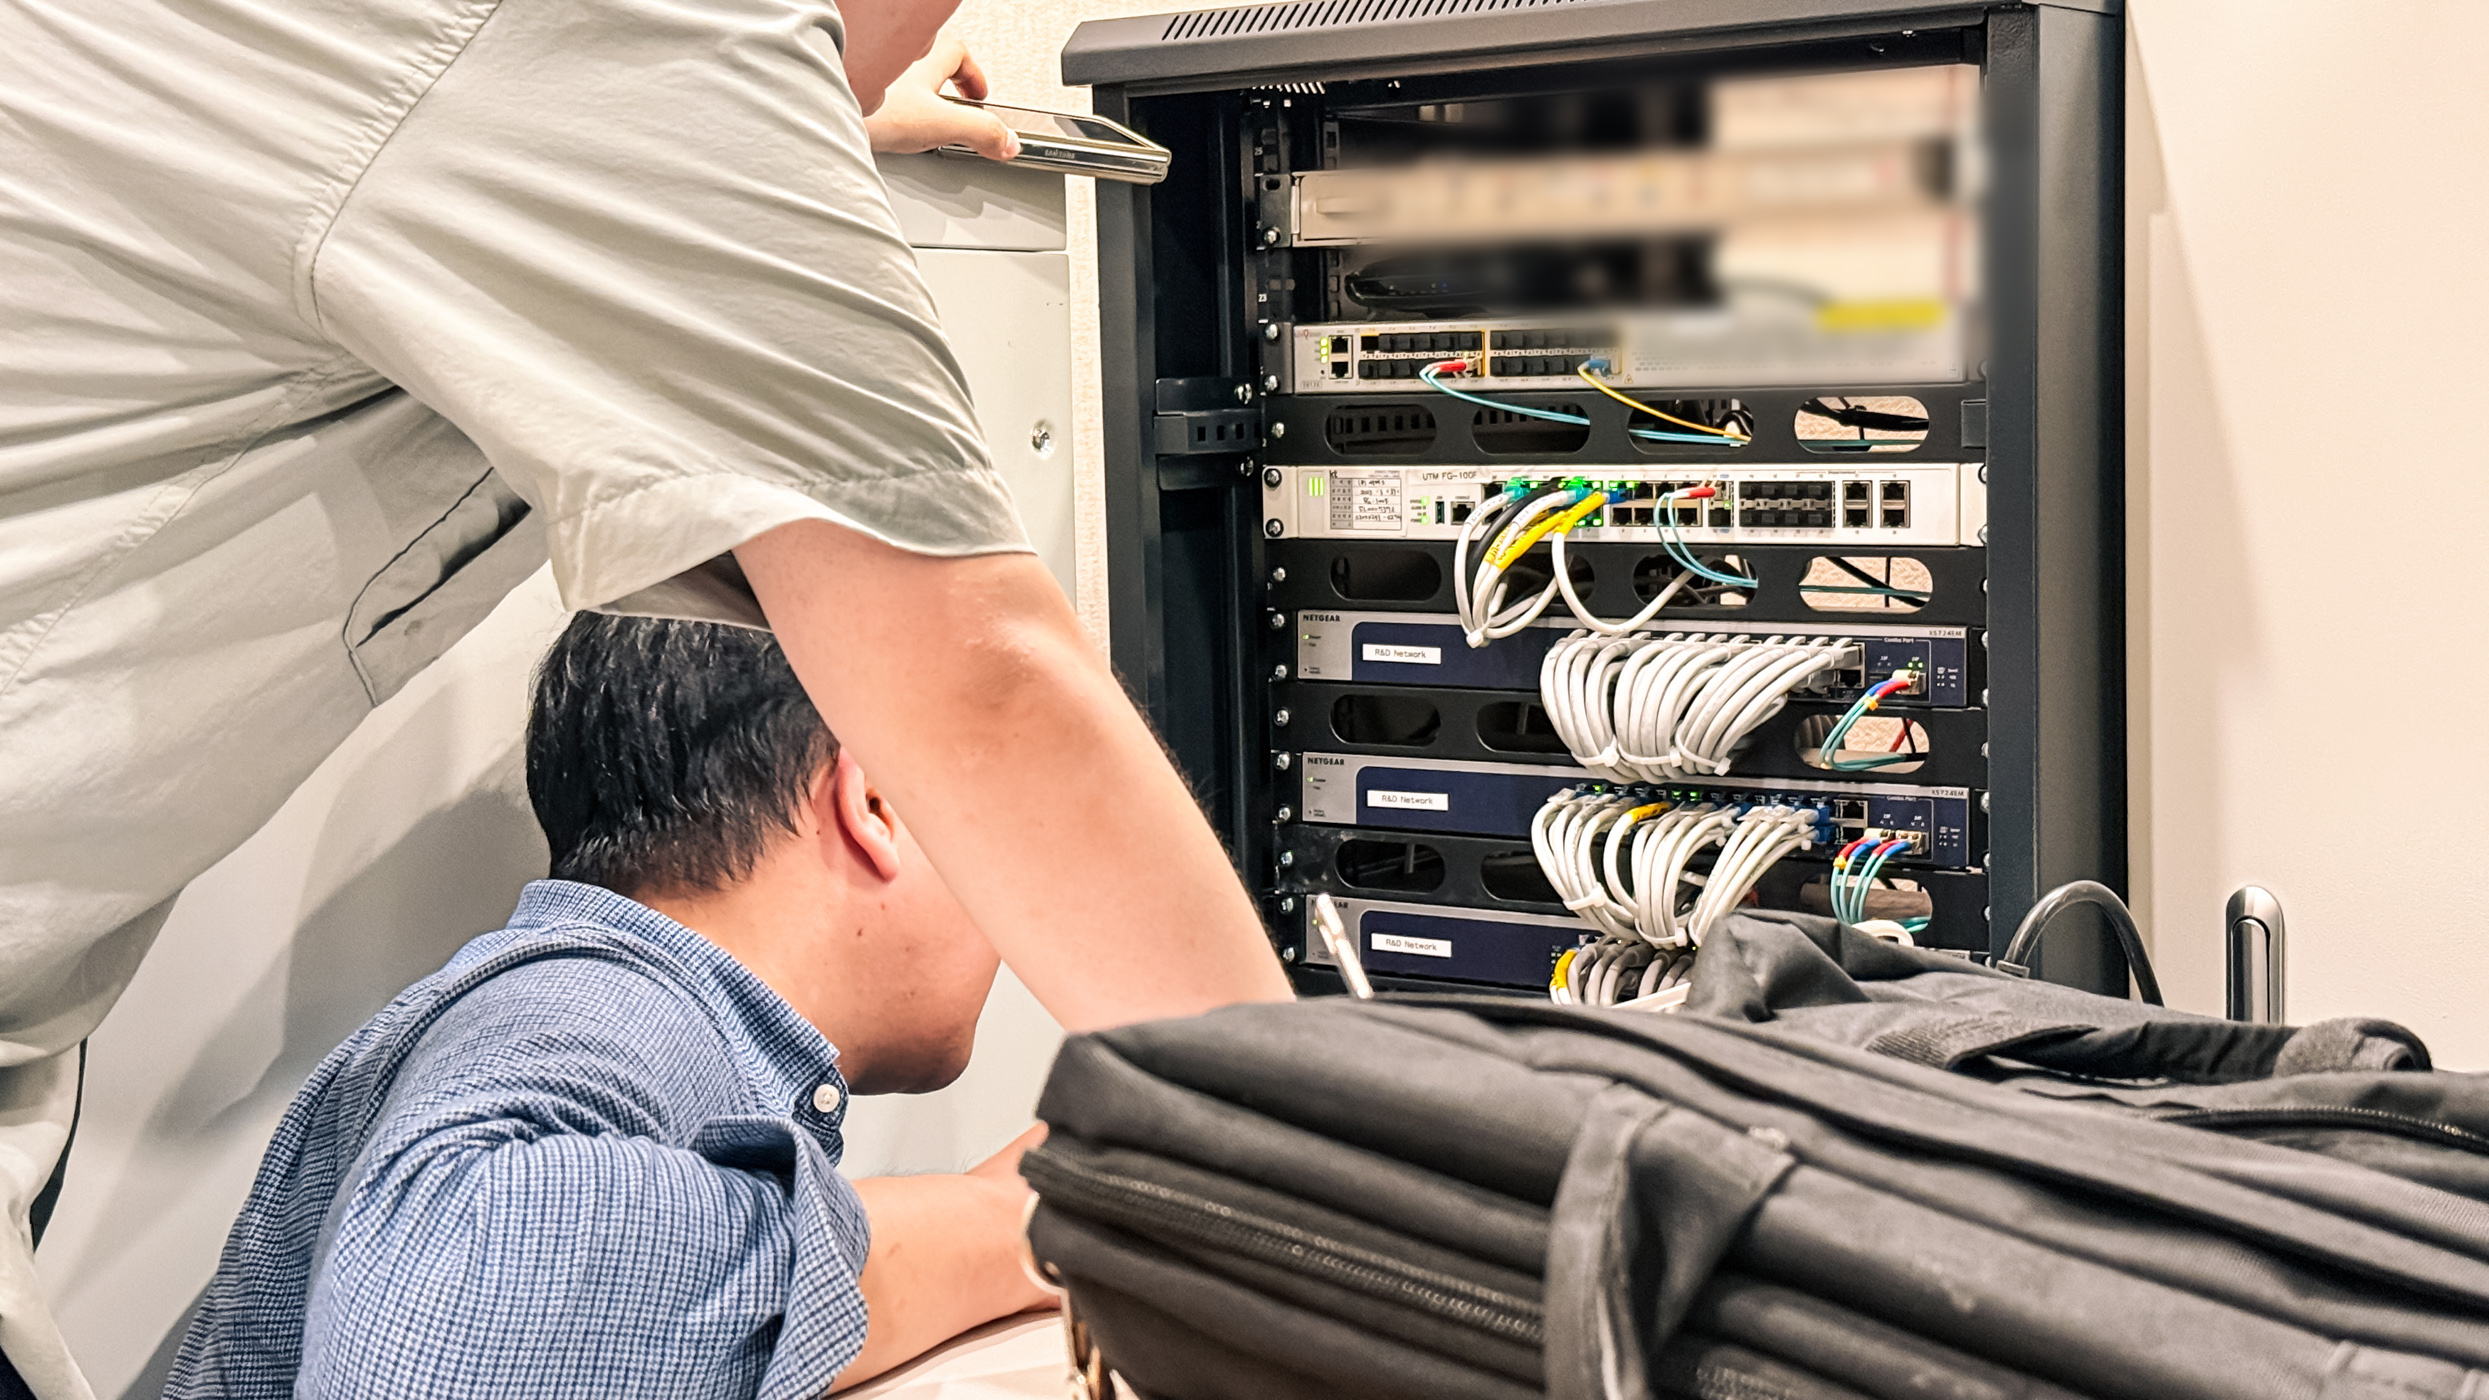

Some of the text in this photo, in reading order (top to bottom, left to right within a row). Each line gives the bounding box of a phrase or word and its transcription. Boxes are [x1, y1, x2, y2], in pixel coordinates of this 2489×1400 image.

[1258, 293, 1268, 302] 23
[1422, 470, 1478, 481] UTM FG-100F
[1303, 614, 1341, 622] NETGEAR
[1375, 648, 1426, 659] R&D Network
[1307, 757, 1345, 766] NETGEAR
[1381, 794, 1433, 805] R&D Network
[1385, 938, 1437, 951] R&D Network
